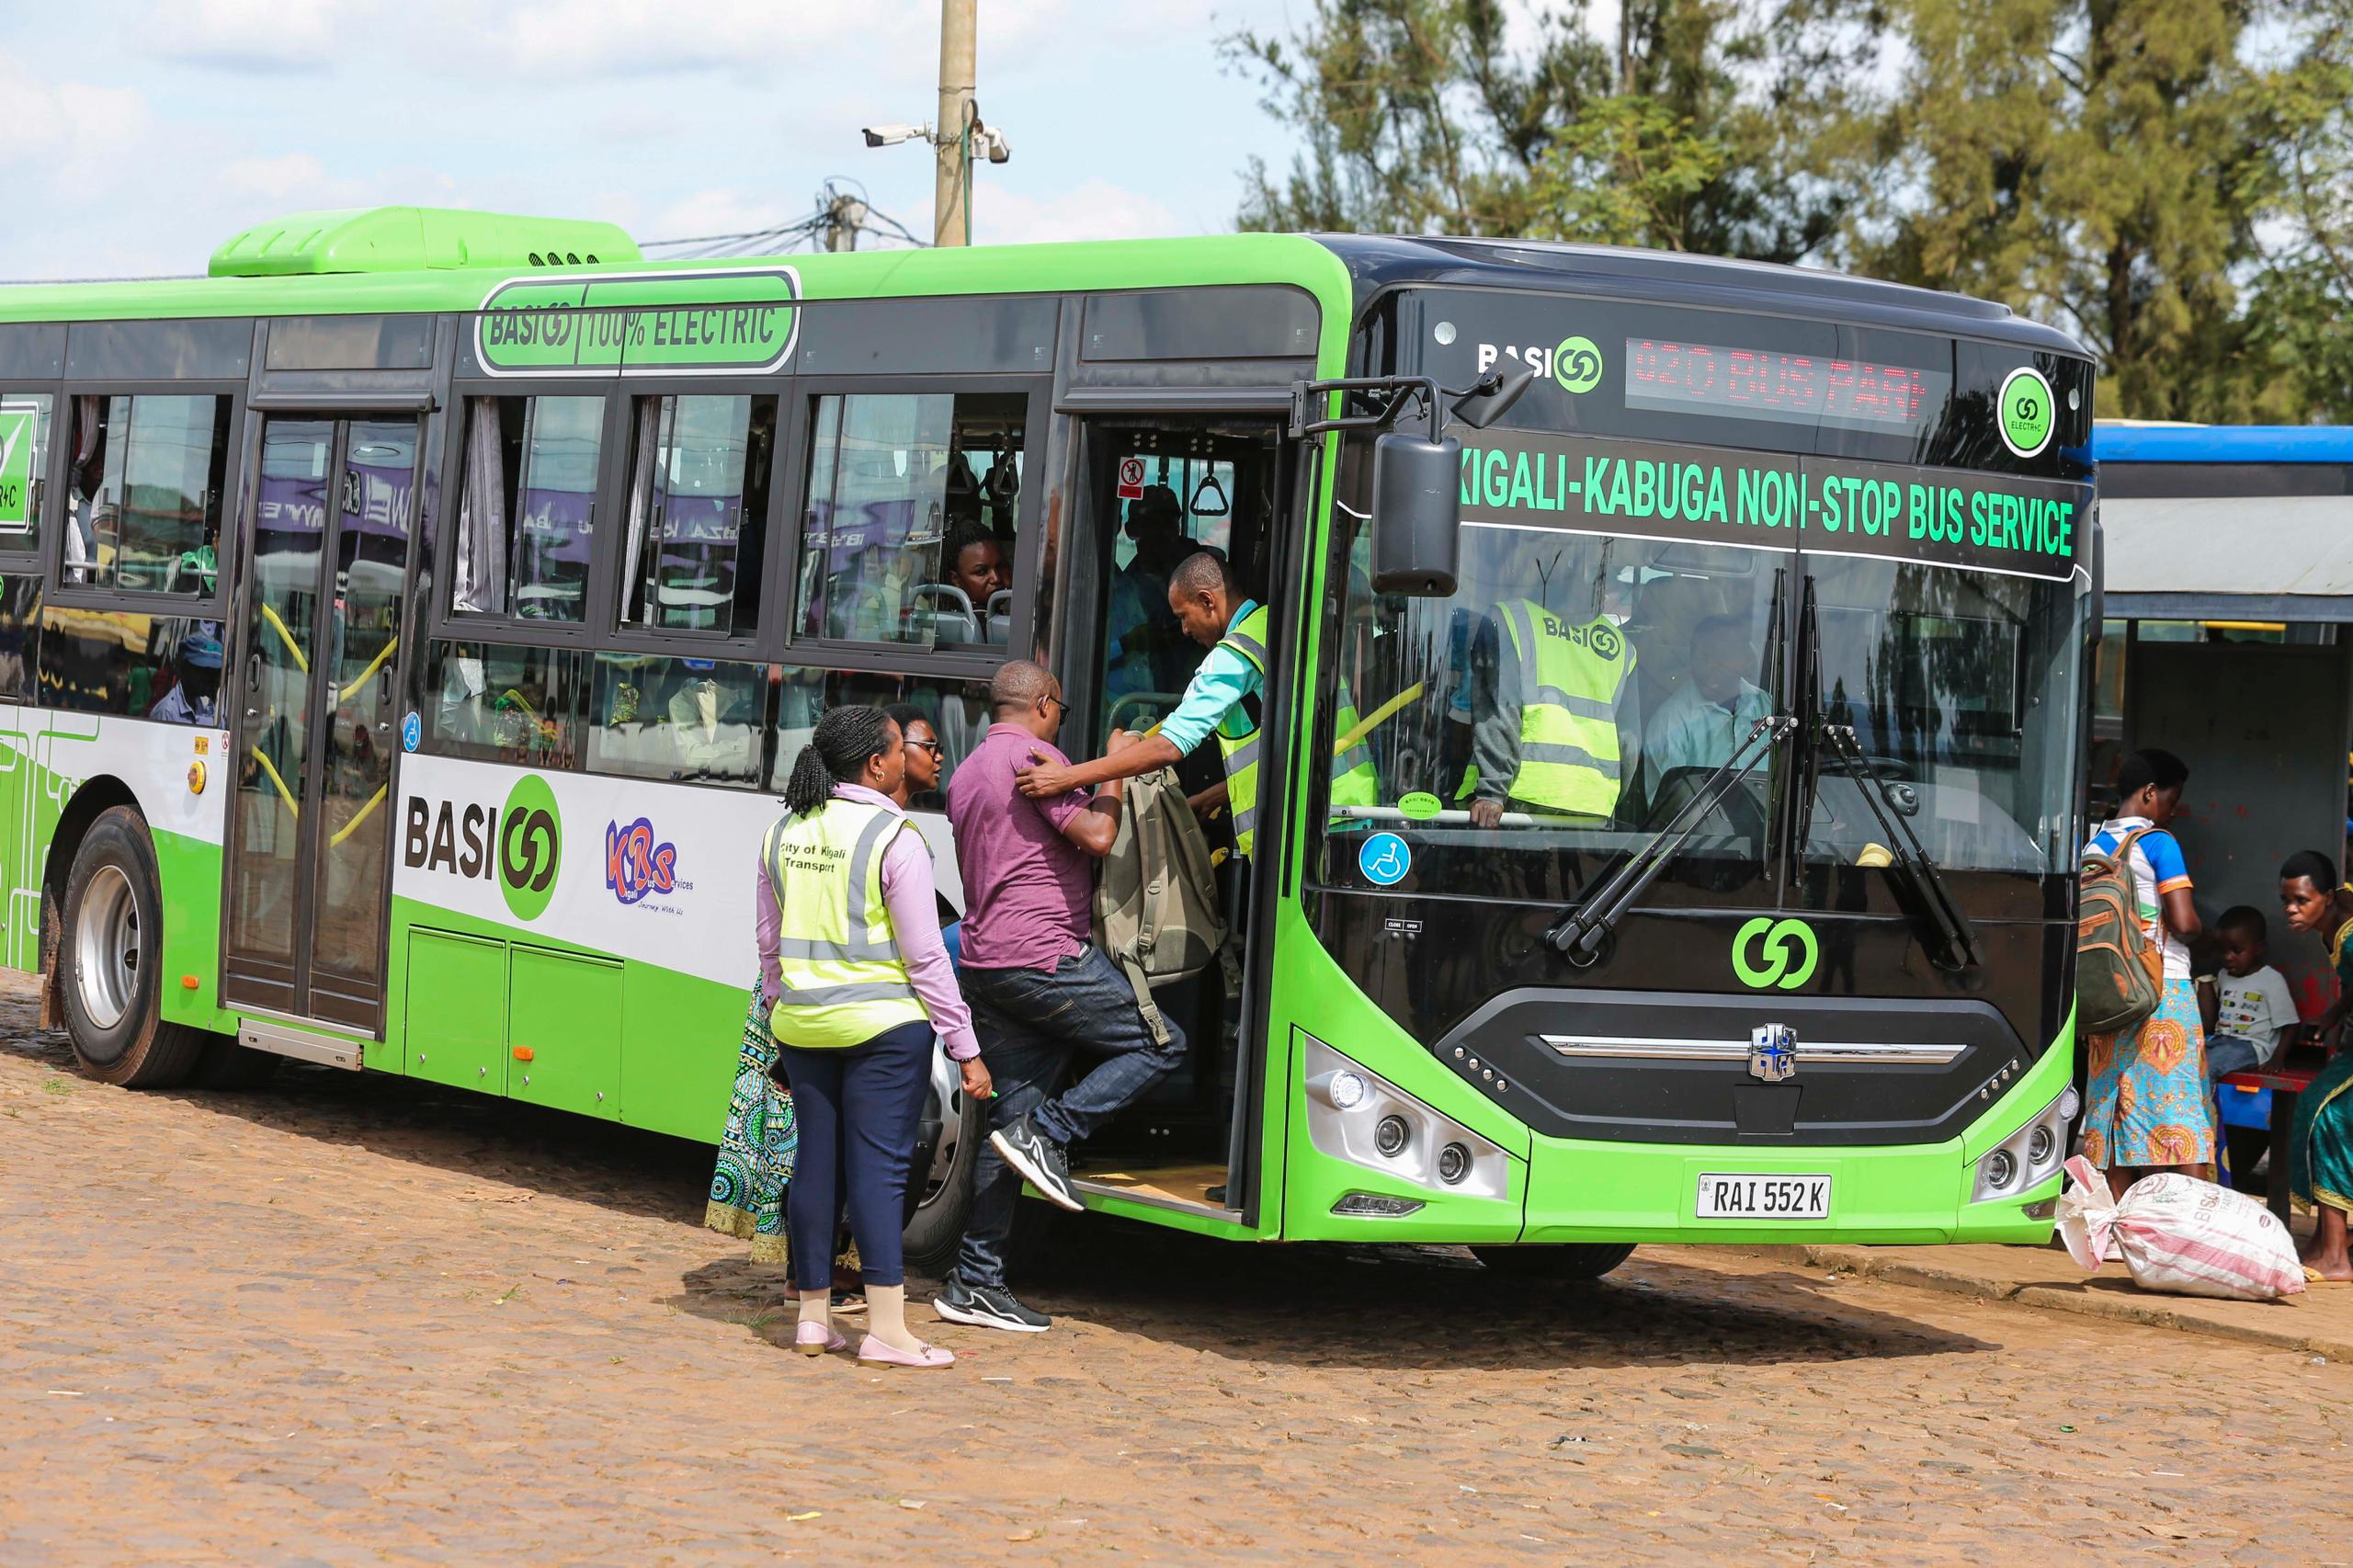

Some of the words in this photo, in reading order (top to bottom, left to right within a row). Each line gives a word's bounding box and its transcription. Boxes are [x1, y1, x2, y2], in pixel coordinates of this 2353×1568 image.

[588, 311, 644, 347] 100%
[654, 307, 776, 346] ELECTRIC
[1736, 468, 1902, 537] NON-STOP
[1909, 483, 1964, 544] BUS
[1971, 490, 2074, 557] SERVICE
[803, 845, 816, 856] of
[821, 845, 847, 860] Kigali
[1713, 1181, 1756, 1212] RAI
